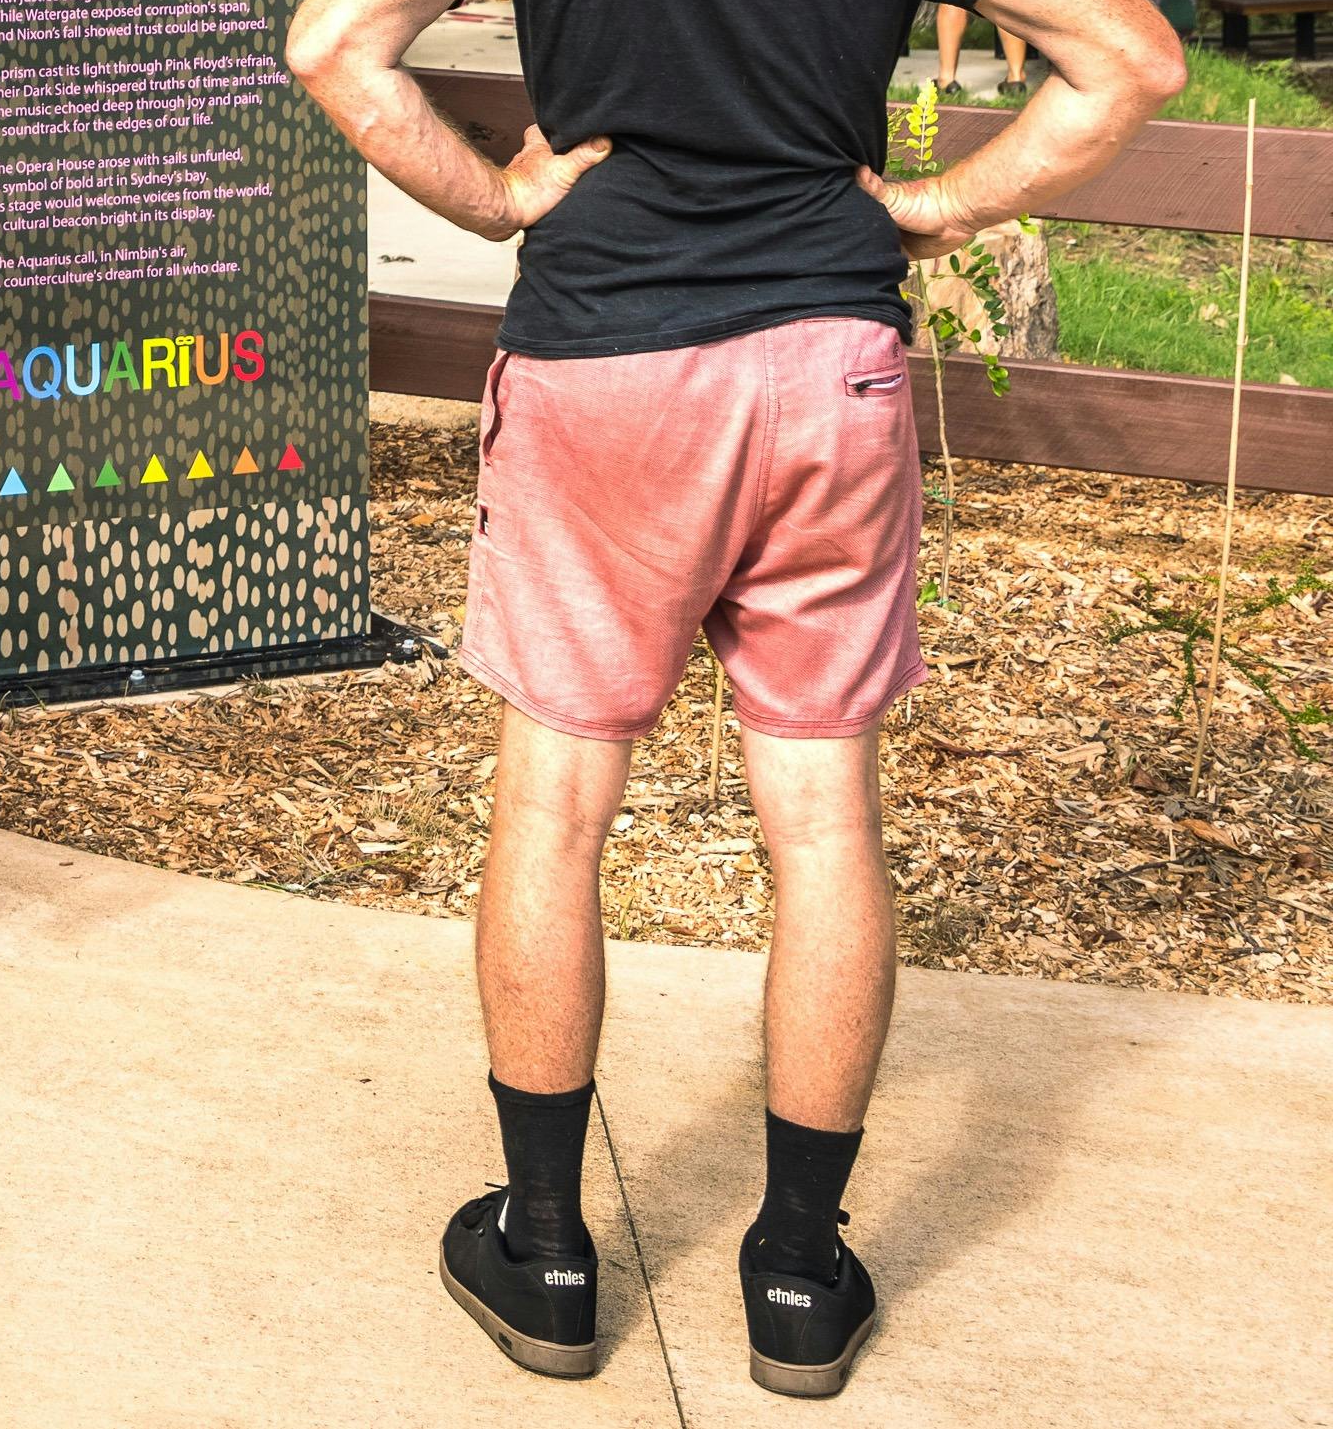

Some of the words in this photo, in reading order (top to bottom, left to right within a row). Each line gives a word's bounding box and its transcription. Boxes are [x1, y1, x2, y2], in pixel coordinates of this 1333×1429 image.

[25, 7, 88, 22] Watergate
[90, 3, 141, 20] exposed
[144, 0, 216, 17] corruption's
[218, 2, 250, 15] span,
[17, 26, 60, 40] Nixon’s
[62, 24, 80, 38] fall
[84, 22, 131, 37] showed
[134, 22, 162, 35] trust
[164, 19, 198, 33] could
[201, 19, 216, 32] be
[219, 16, 267, 34] ignored.
[1, 66, 35, 82] prism
[38, 65, 63, 77] cast
[66, 63, 79, 76] its
[82, 61, 110, 77] light
[113, 59, 162, 75] through
[165, 57, 191, 70] Pink
[193, 55, 233, 71] Floyd’s
[235, 53, 276, 67] refrain,
[23, 83, 52, 97] Dark
[54, 81, 80, 95] Side
[83, 78, 146, 95] whispered
[149, 76, 185, 90] truths
[187, 75, 200, 88] of
[202, 75, 229, 87] time
[231, 72, 254, 86] and
[257, 70, 289, 85] strife.
[15, 102, 51, 116] music
[54, 99, 99, 114] echoed
[102, 98, 133, 113] deep
[136, 94, 184, 111] through
[186, 94, 205, 110] joy
[207, 92, 230, 106] and
[233, 91, 262, 107] pain,
[1, 119, 70, 136] soundtrack
[72, 118, 90, 132] for
[92, 117, 113, 131] the
[115, 116, 152, 132] edges
[154, 114, 167, 127] of
[169, 116, 190, 126] our
[192, 111, 213, 125] life.
[15, 160, 53, 175] Opera
[56, 158, 95, 171] House
[97, 157, 130, 168] arose
[132, 152, 159, 166] with
[162, 150, 187, 164] sails
[190, 147, 243, 163] unfurled,
[2, 177, 47, 196] symbol
[50, 176, 63, 190] of
[65, 174, 93, 189] bold
[96, 174, 113, 187] art
[116, 174, 127, 186] in
[130, 170, 182, 187] Sydney's
[184, 169, 208, 184] bay.
[8, 200, 41, 213] stage
[44, 194, 82, 209] would
[85, 193, 140, 206] welcome
[142, 190, 180, 203] voices
[182, 187, 211, 200] from
[213, 185, 233, 198] the
[235, 182, 272, 197] world,
[2, 215, 49, 230] cultural
[52, 215, 97, 227] beacon
[100, 210, 137, 226] bright
[140, 210, 151, 222] in
[154, 209, 168, 220] its
[170, 205, 215, 221] display.
[17, 253, 71, 269] Aquarius
[74, 250, 97, 264] call,
[100, 250, 111, 261] in
[115, 246, 167, 261] Nimbin's
[169, 244, 187, 257] air,
[3, 269, 102, 287] counterculture's
[104, 267, 143, 280] dream
[146, 264, 163, 277] for
[165, 263, 179, 276] all
[182, 261, 208, 275] who
[210, 260, 240, 272] dare.
[766, 1287, 812, 1308] etnies
